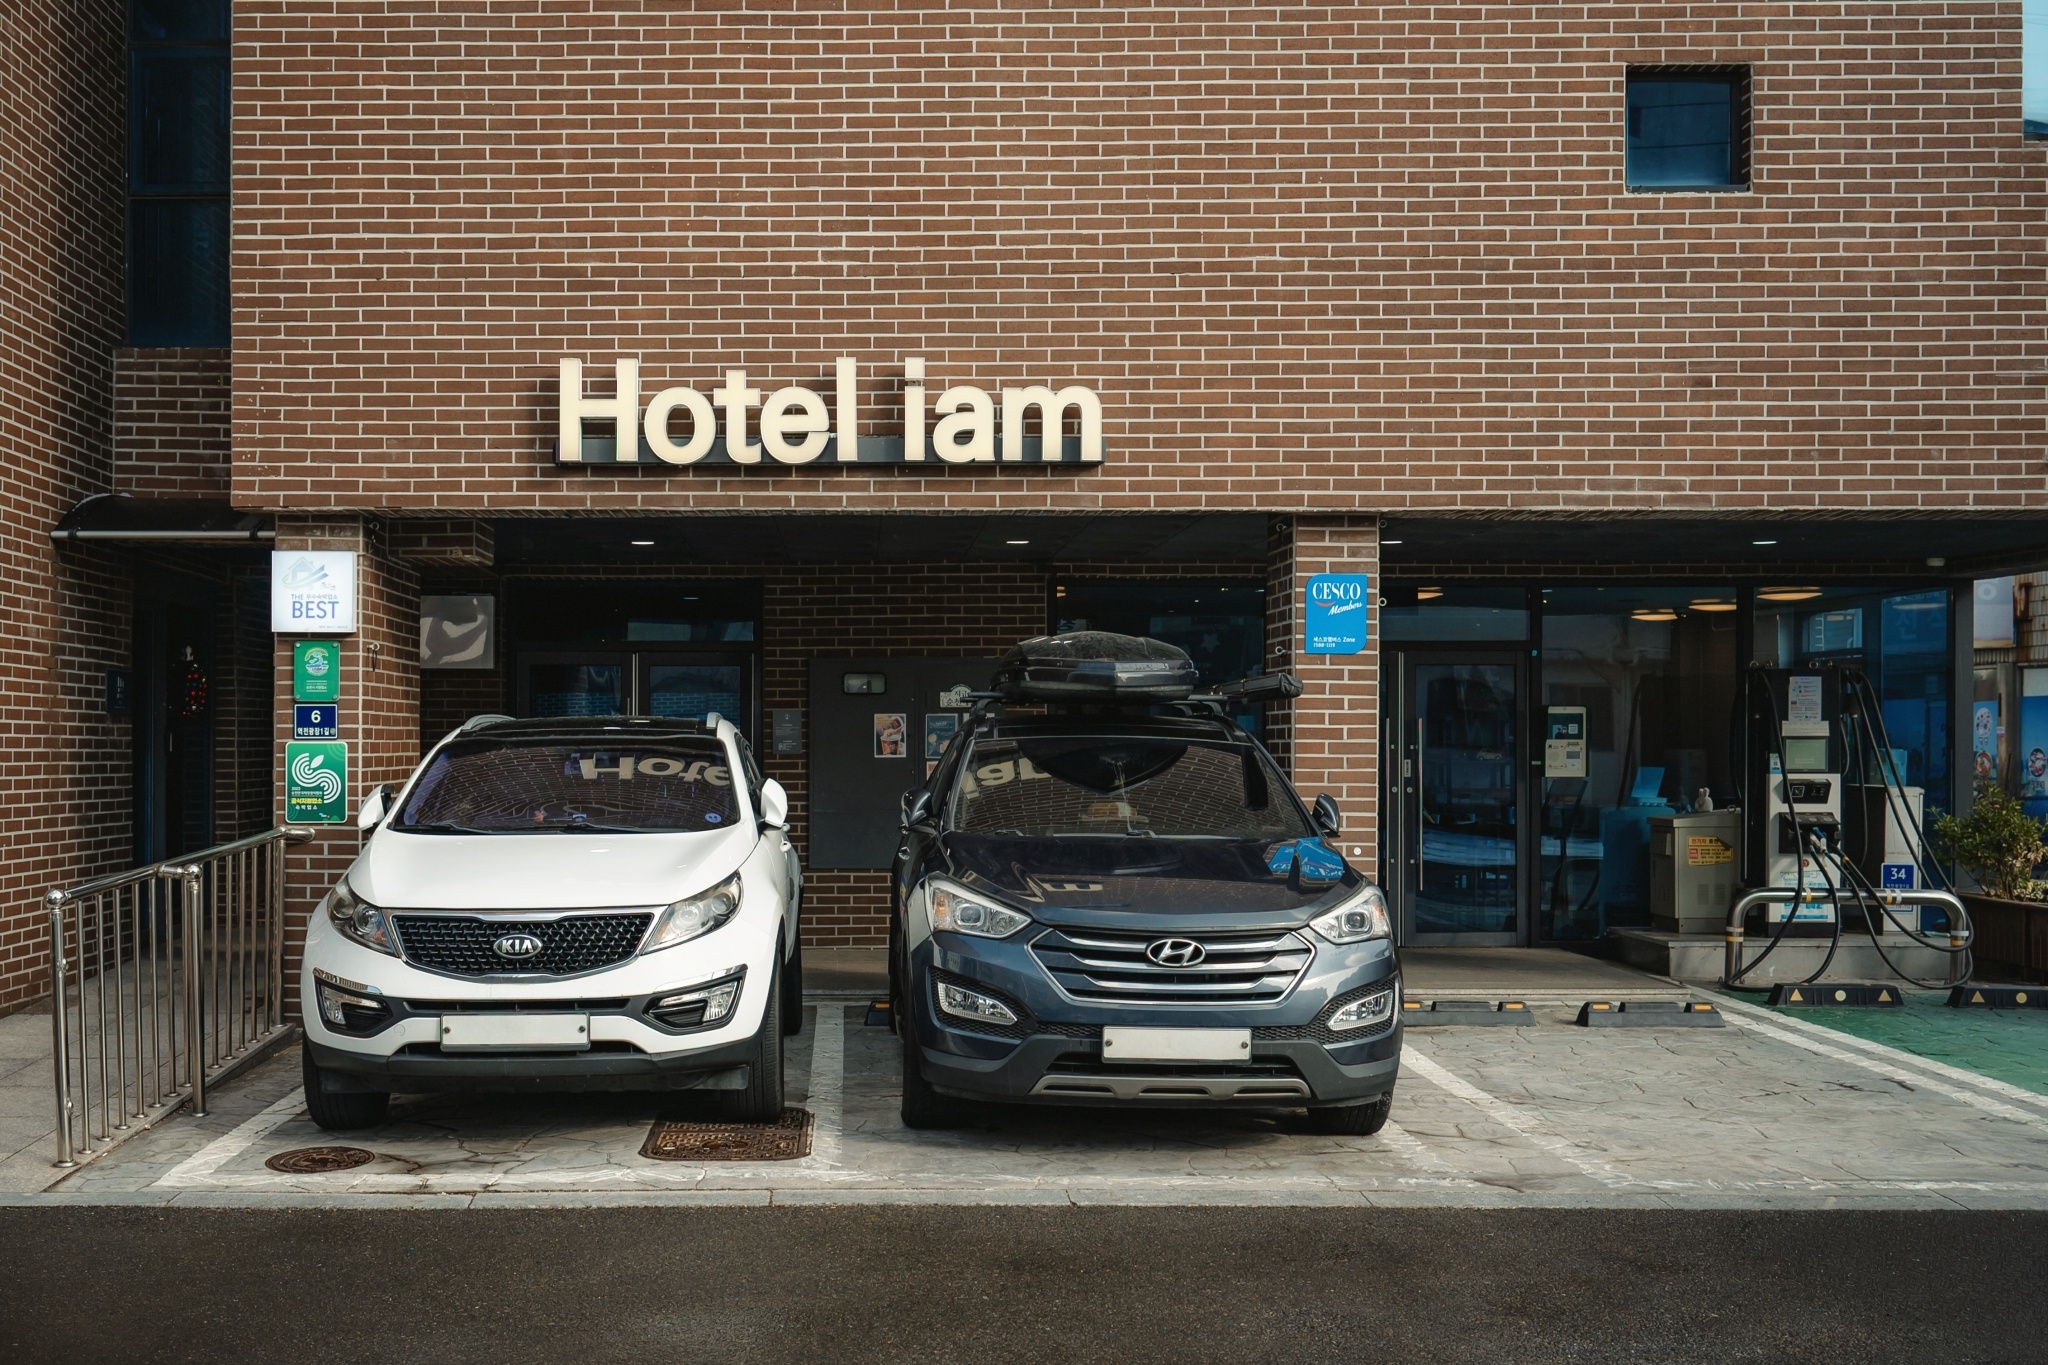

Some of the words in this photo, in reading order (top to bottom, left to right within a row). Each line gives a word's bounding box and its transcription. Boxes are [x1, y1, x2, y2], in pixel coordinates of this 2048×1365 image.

[559, 356, 857, 464] Hotel
[904, 356, 1102, 464] iam
[1312, 582, 1361, 600] CESCO
[292, 600, 339, 619] BEST
[1327, 600, 1363, 616] Members
[311, 710, 321, 723] 6
[297, 727, 330, 736] 역전광장1길
[1890, 867, 1906, 880] 34
[501, 939, 534, 953] KIA
